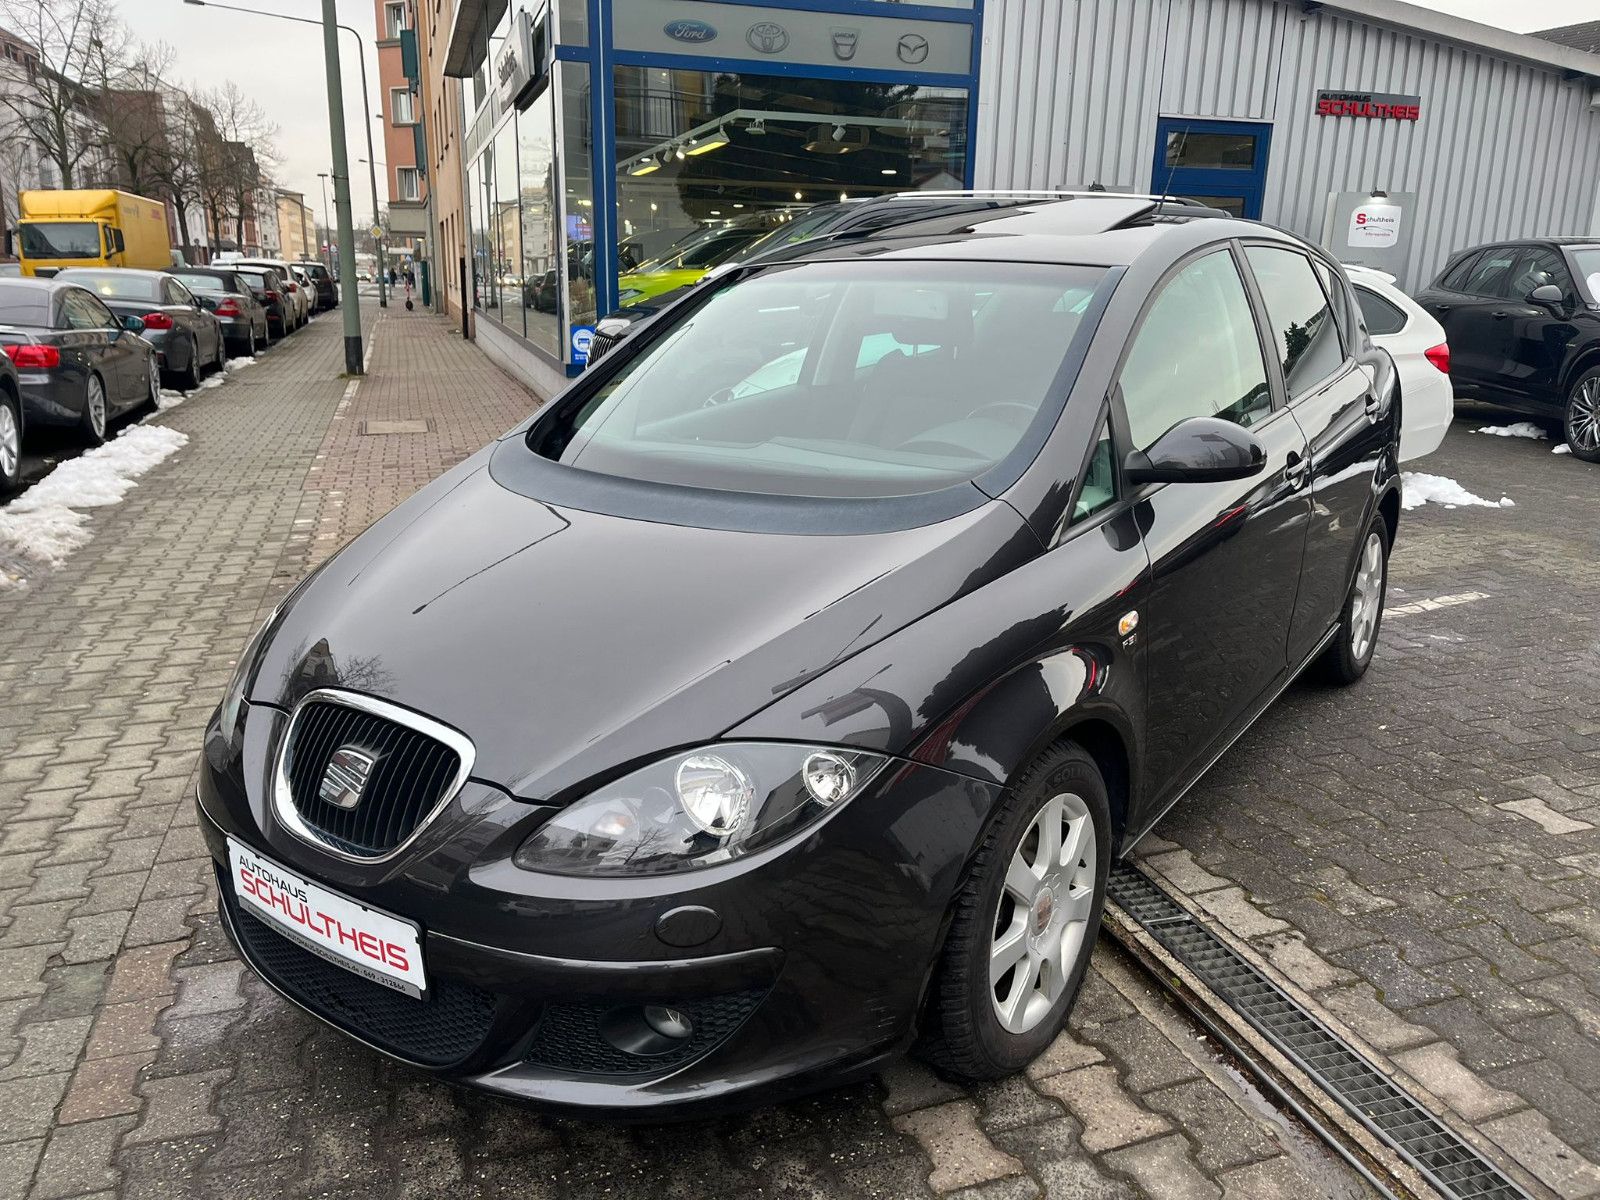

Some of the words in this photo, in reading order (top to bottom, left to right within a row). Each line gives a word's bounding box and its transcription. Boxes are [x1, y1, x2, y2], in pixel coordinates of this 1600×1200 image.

[675, 24, 706, 39] Ford
[1320, 93, 1371, 102] AUTOHAUS
[1318, 99, 1420, 119] SCHULTHEIS
[1356, 213, 1395, 224] Schultheis
[239, 855, 308, 903] AUTOHAUS
[240, 868, 410, 971] SCHULTHEIS
